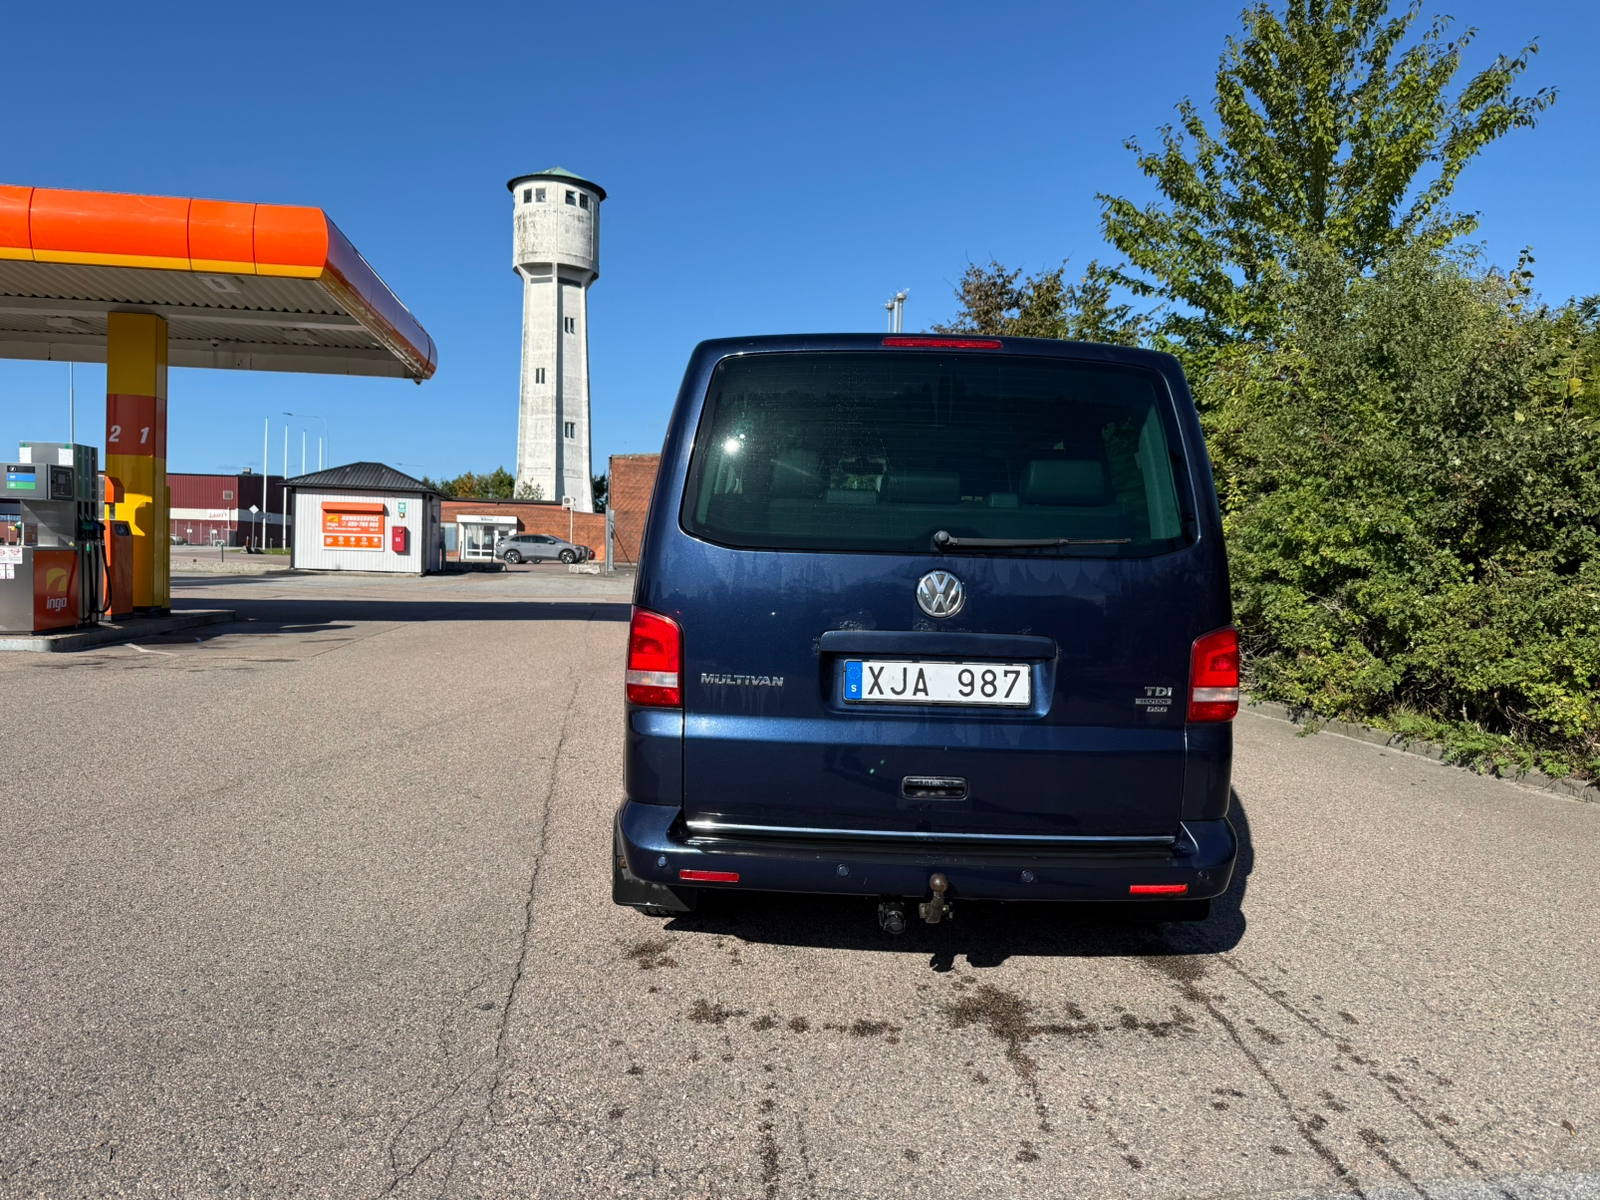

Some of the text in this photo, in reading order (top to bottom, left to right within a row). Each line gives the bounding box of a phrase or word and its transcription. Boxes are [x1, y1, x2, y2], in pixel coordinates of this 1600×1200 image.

[109, 425, 150, 444] 2 1
[46, 596, 68, 612] ingo
[701, 673, 784, 687] MULTIVAN
[850, 666, 1021, 699] S XJA 987
[1144, 686, 1173, 696] TDI
